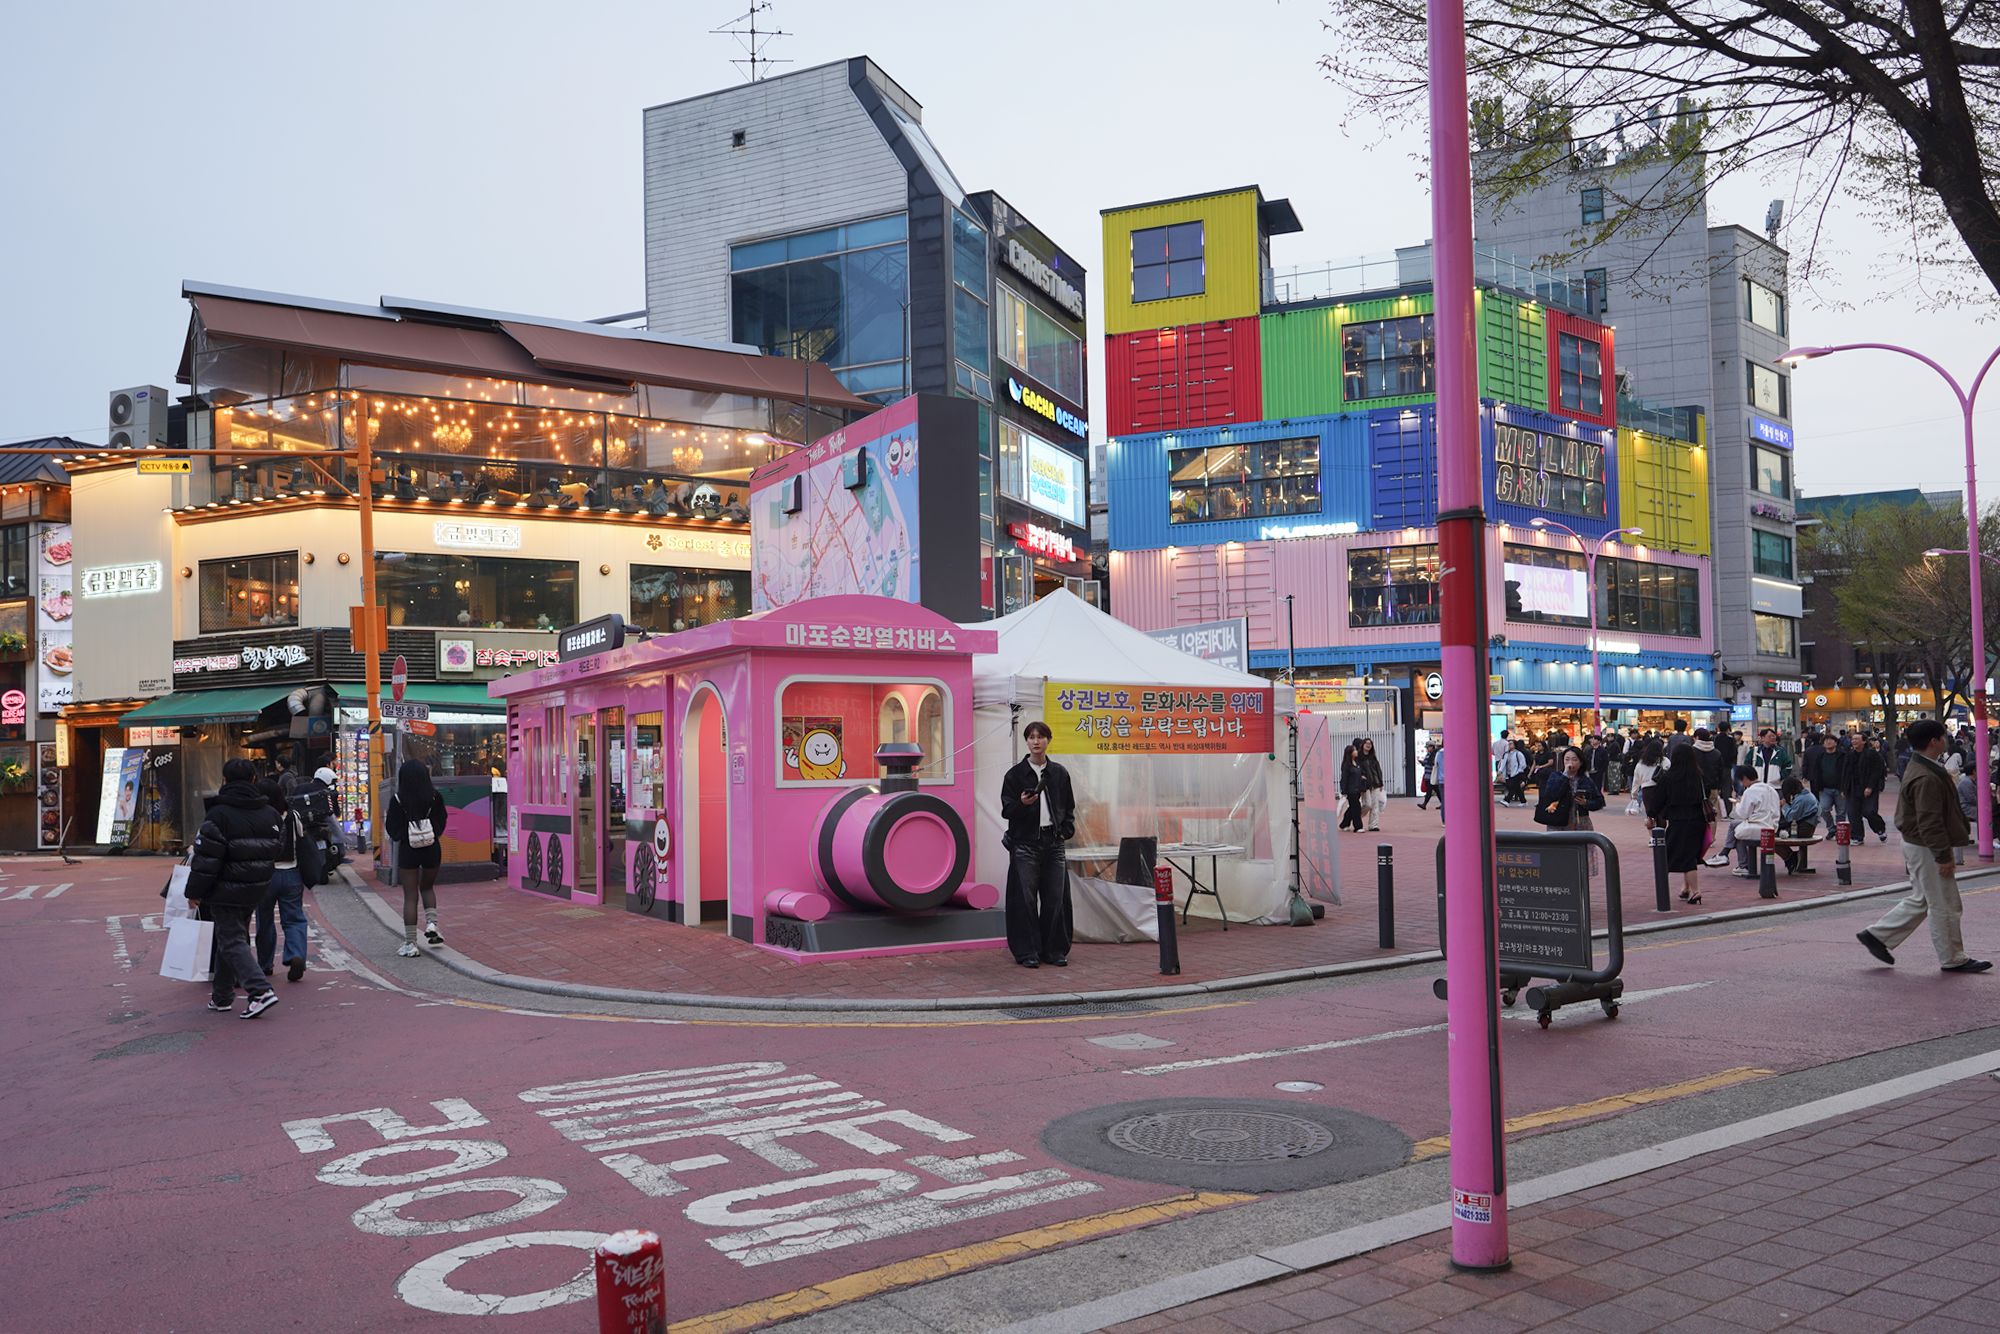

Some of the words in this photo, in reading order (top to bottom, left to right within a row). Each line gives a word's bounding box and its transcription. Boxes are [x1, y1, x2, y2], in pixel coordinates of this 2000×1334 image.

[1009, 239, 1084, 320] CHRISTMAS
[1022, 386, 1056, 422] GACHA
[1056, 406, 1085, 438] OCEAN
[1495, 425, 1600, 480] MPLAY
[140, 463, 161, 471] CCTV
[667, 536, 714, 551] Series:
[566, 627, 607, 652] 마포순환열차버스
[786, 623, 956, 651] 마포순환열차버스
[173, 655, 239, 674] 참숯구이전문점
[1057, 689, 1136, 712] 상권보호,
[1141, 691, 1226, 713] 문화사수를
[1230, 692, 1264, 714] 위해
[1907, 693, 1921, 705] 101
[2, 709, 25, 717] KOREAN
[384, 703, 428, 719] 일방통행
[1075, 715, 1132, 738] 서명을
[1138, 716, 1246, 738] 부탁드립니다.
[1158, 742, 1171, 751] 역사
[1173, 742, 1185, 751] 반대
[1498, 853, 1533, 864] 레드로드
